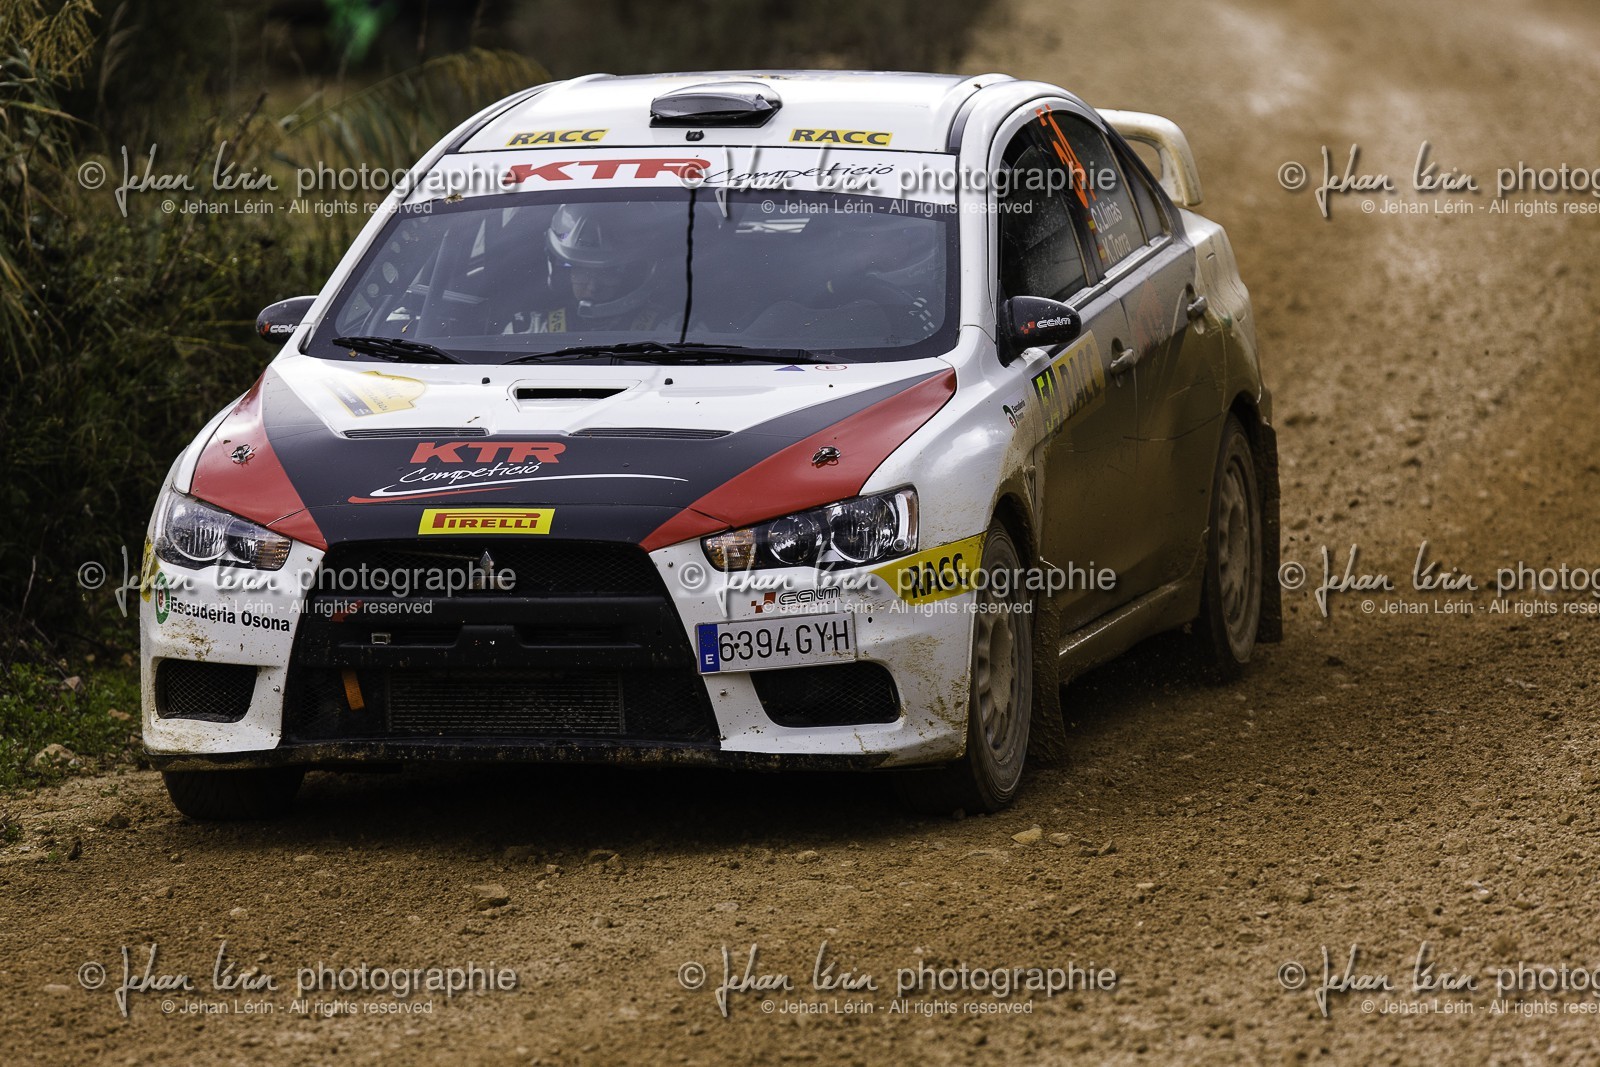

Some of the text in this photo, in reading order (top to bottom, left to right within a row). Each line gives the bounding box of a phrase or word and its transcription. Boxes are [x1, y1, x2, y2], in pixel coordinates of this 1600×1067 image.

[509, 130, 605, 146] RACC
[792, 129, 894, 145] RACC
[504, 158, 711, 184] KTR
[410, 442, 566, 463] KTR
[400, 461, 541, 484] Competició
[432, 513, 541, 529] PIRELLI
[908, 553, 969, 599] RACC
[170, 596, 290, 632] Escuderia Osona
[719, 620, 850, 662] 6394 GYH
[705, 654, 714, 664] E
